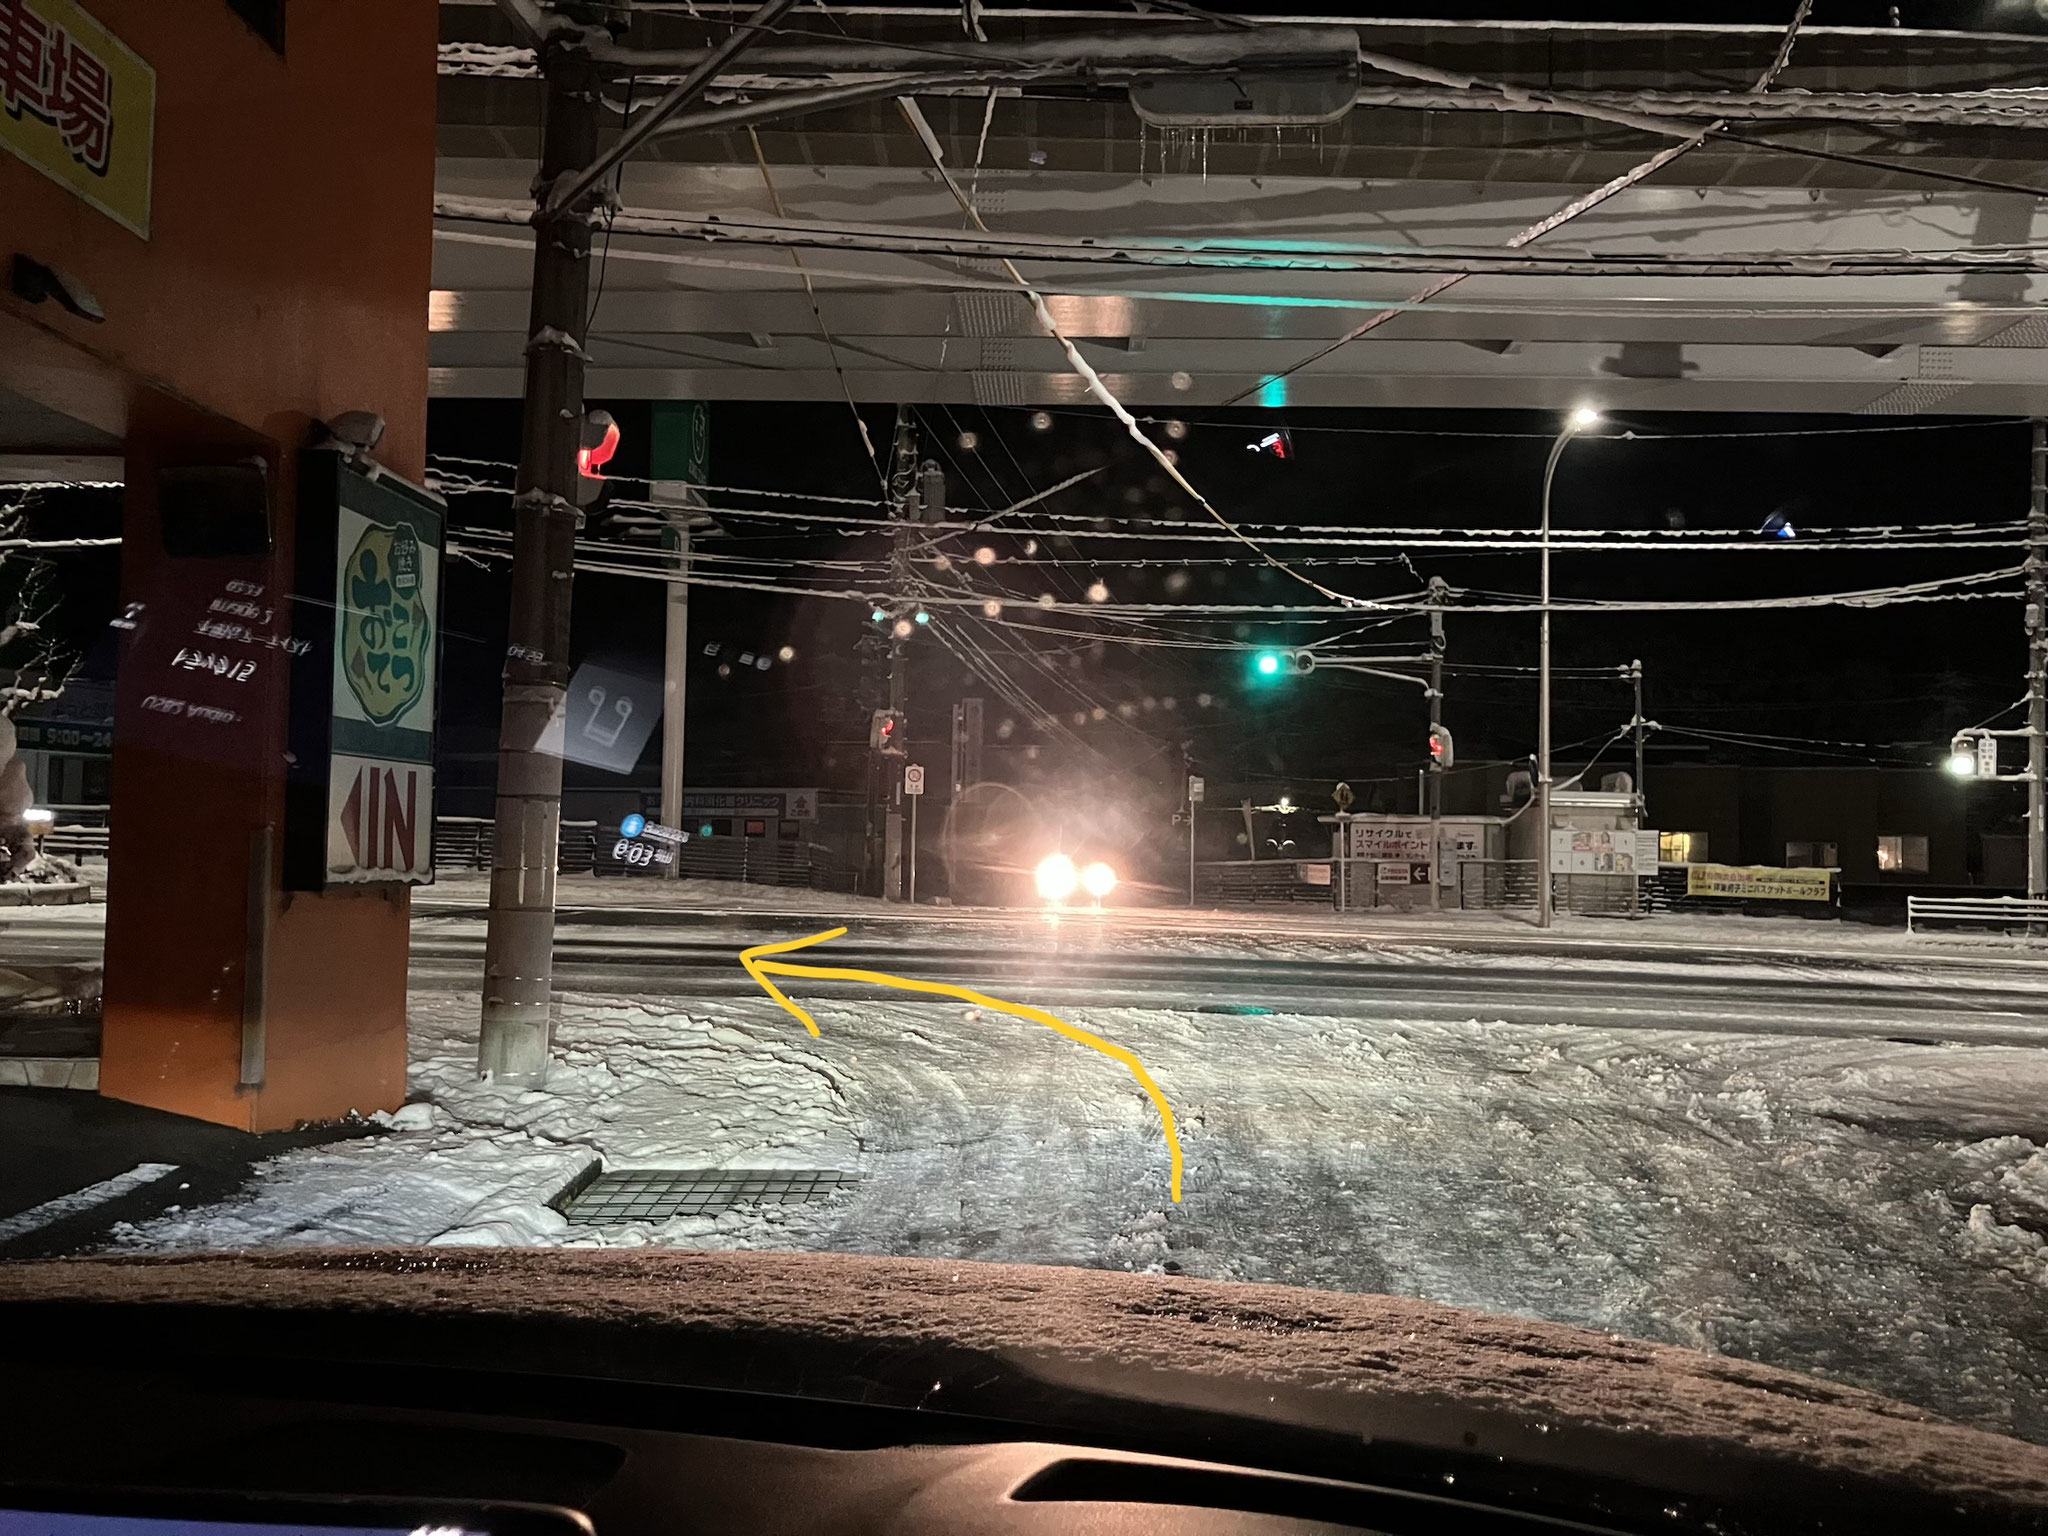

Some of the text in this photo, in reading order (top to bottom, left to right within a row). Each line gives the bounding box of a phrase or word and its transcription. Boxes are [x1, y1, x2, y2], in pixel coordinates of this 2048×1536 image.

[366, 766, 417, 873] IN
[1171, 814, 1181, 826] P
[1355, 828, 1412, 839] リサイクルで
[1356, 839, 1428, 850] スマイルポイント
